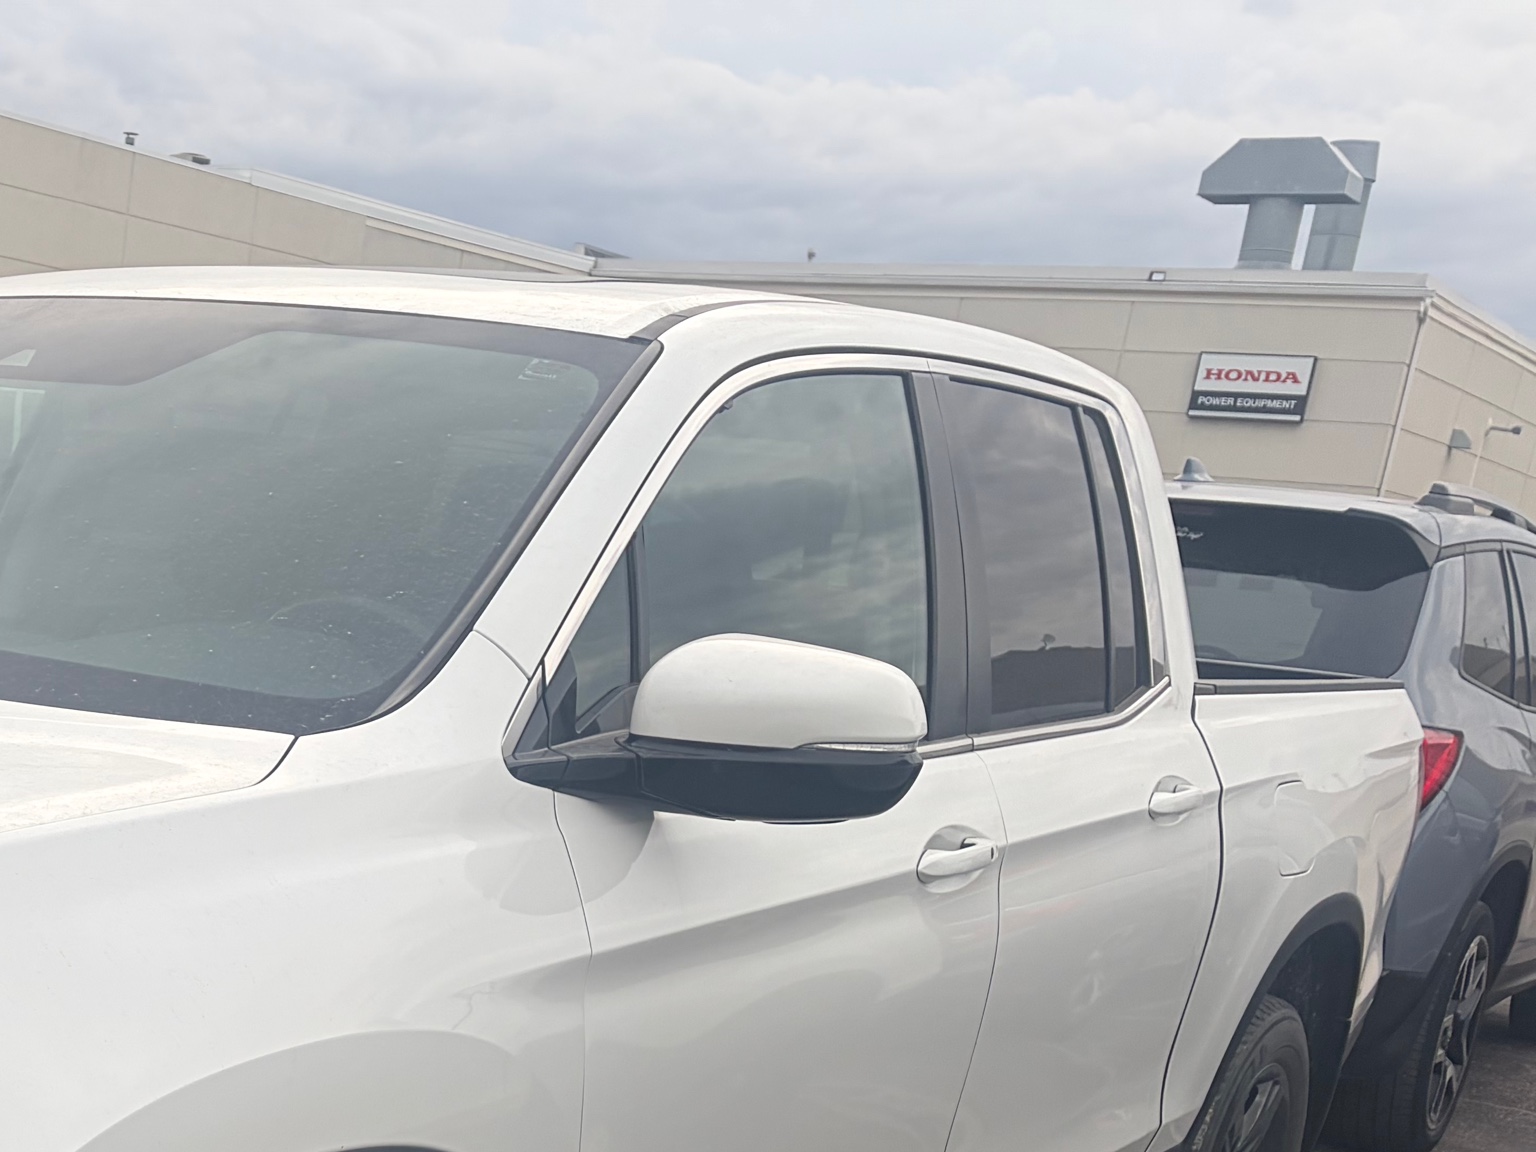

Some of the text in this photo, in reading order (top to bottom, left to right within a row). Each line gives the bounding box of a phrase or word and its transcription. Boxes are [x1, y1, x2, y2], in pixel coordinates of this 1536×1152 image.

[1203, 367, 1302, 384] HONDA
[1197, 396, 1298, 409] POWER EQUIPMENT
